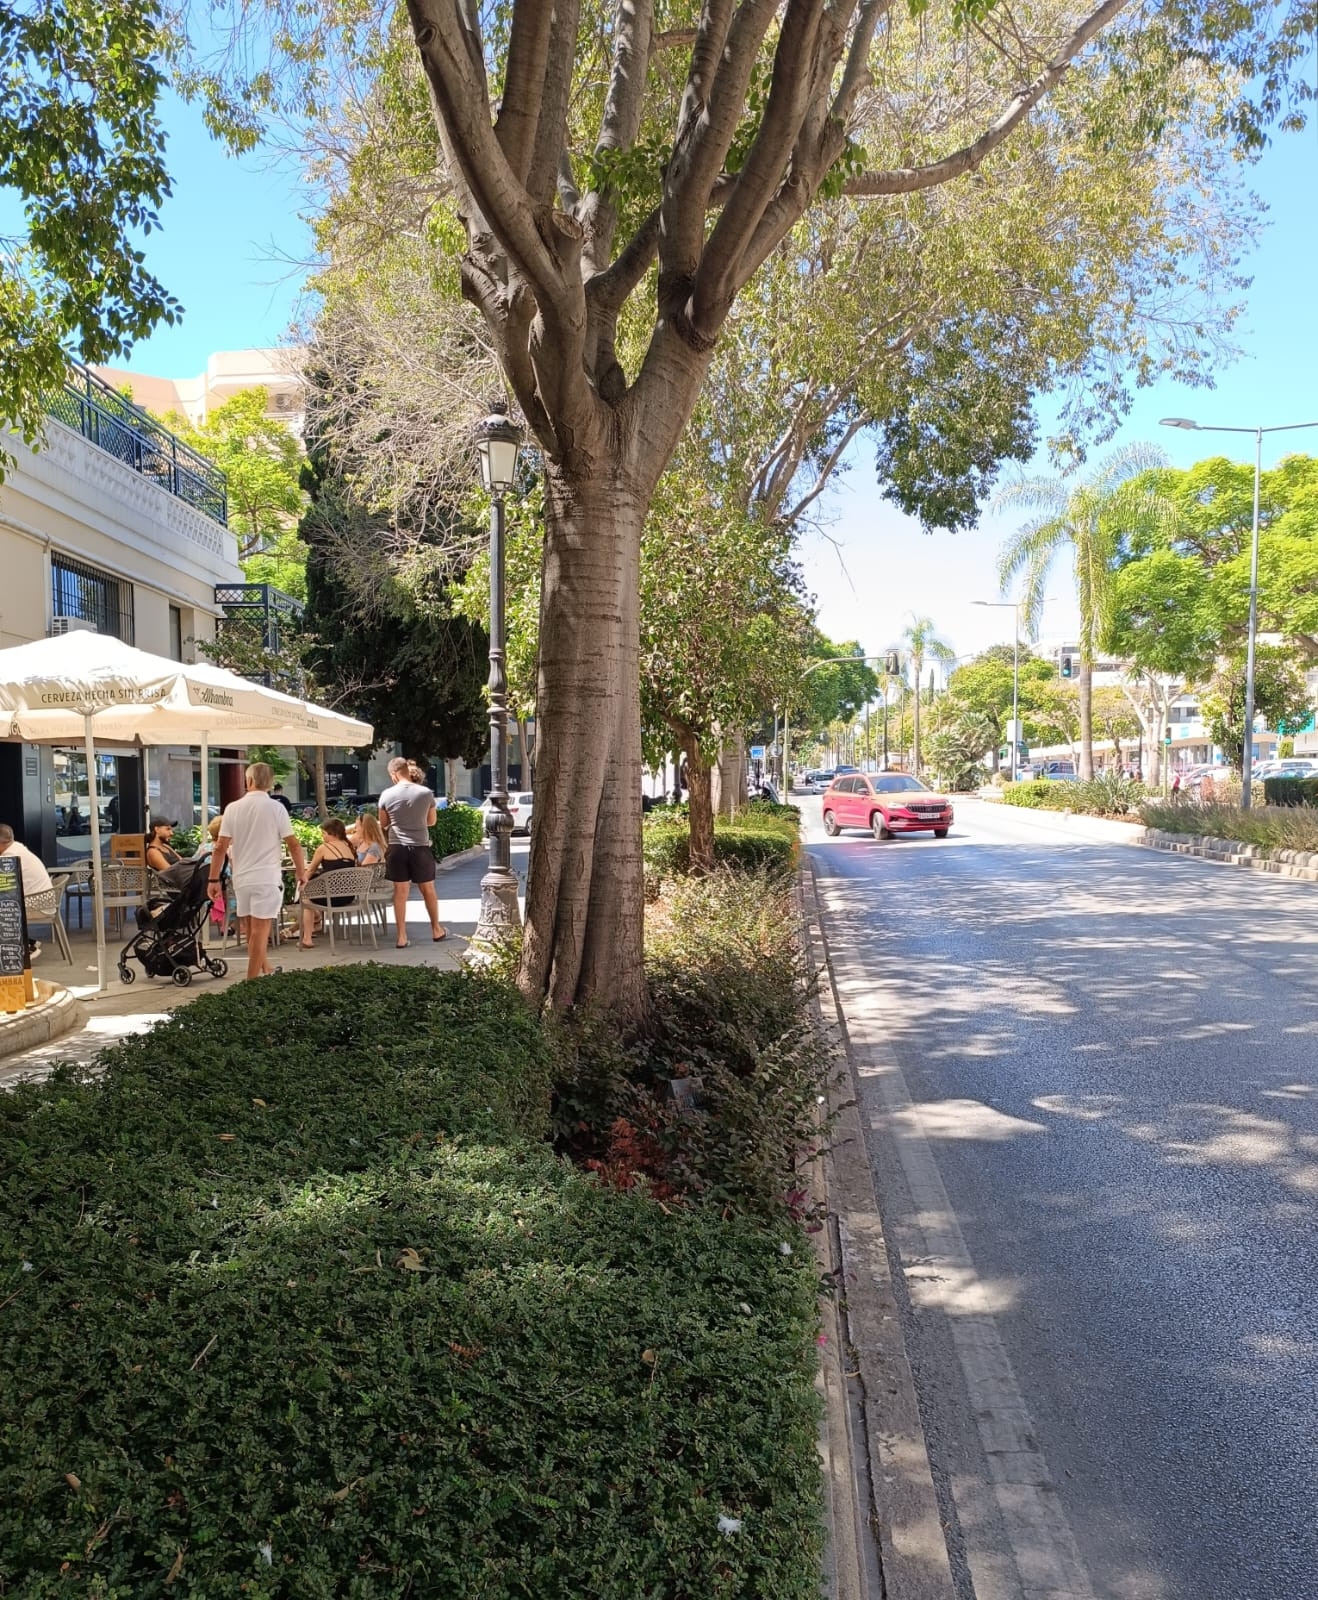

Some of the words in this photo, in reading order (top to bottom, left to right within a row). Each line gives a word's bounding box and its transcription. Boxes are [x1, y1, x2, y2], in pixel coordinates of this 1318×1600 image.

[41, 691, 82, 703] CERVEZA
[84, 689, 116, 701] HECHA
[118, 688, 135, 699] SIN
[201, 688, 234, 707] Alhambra
